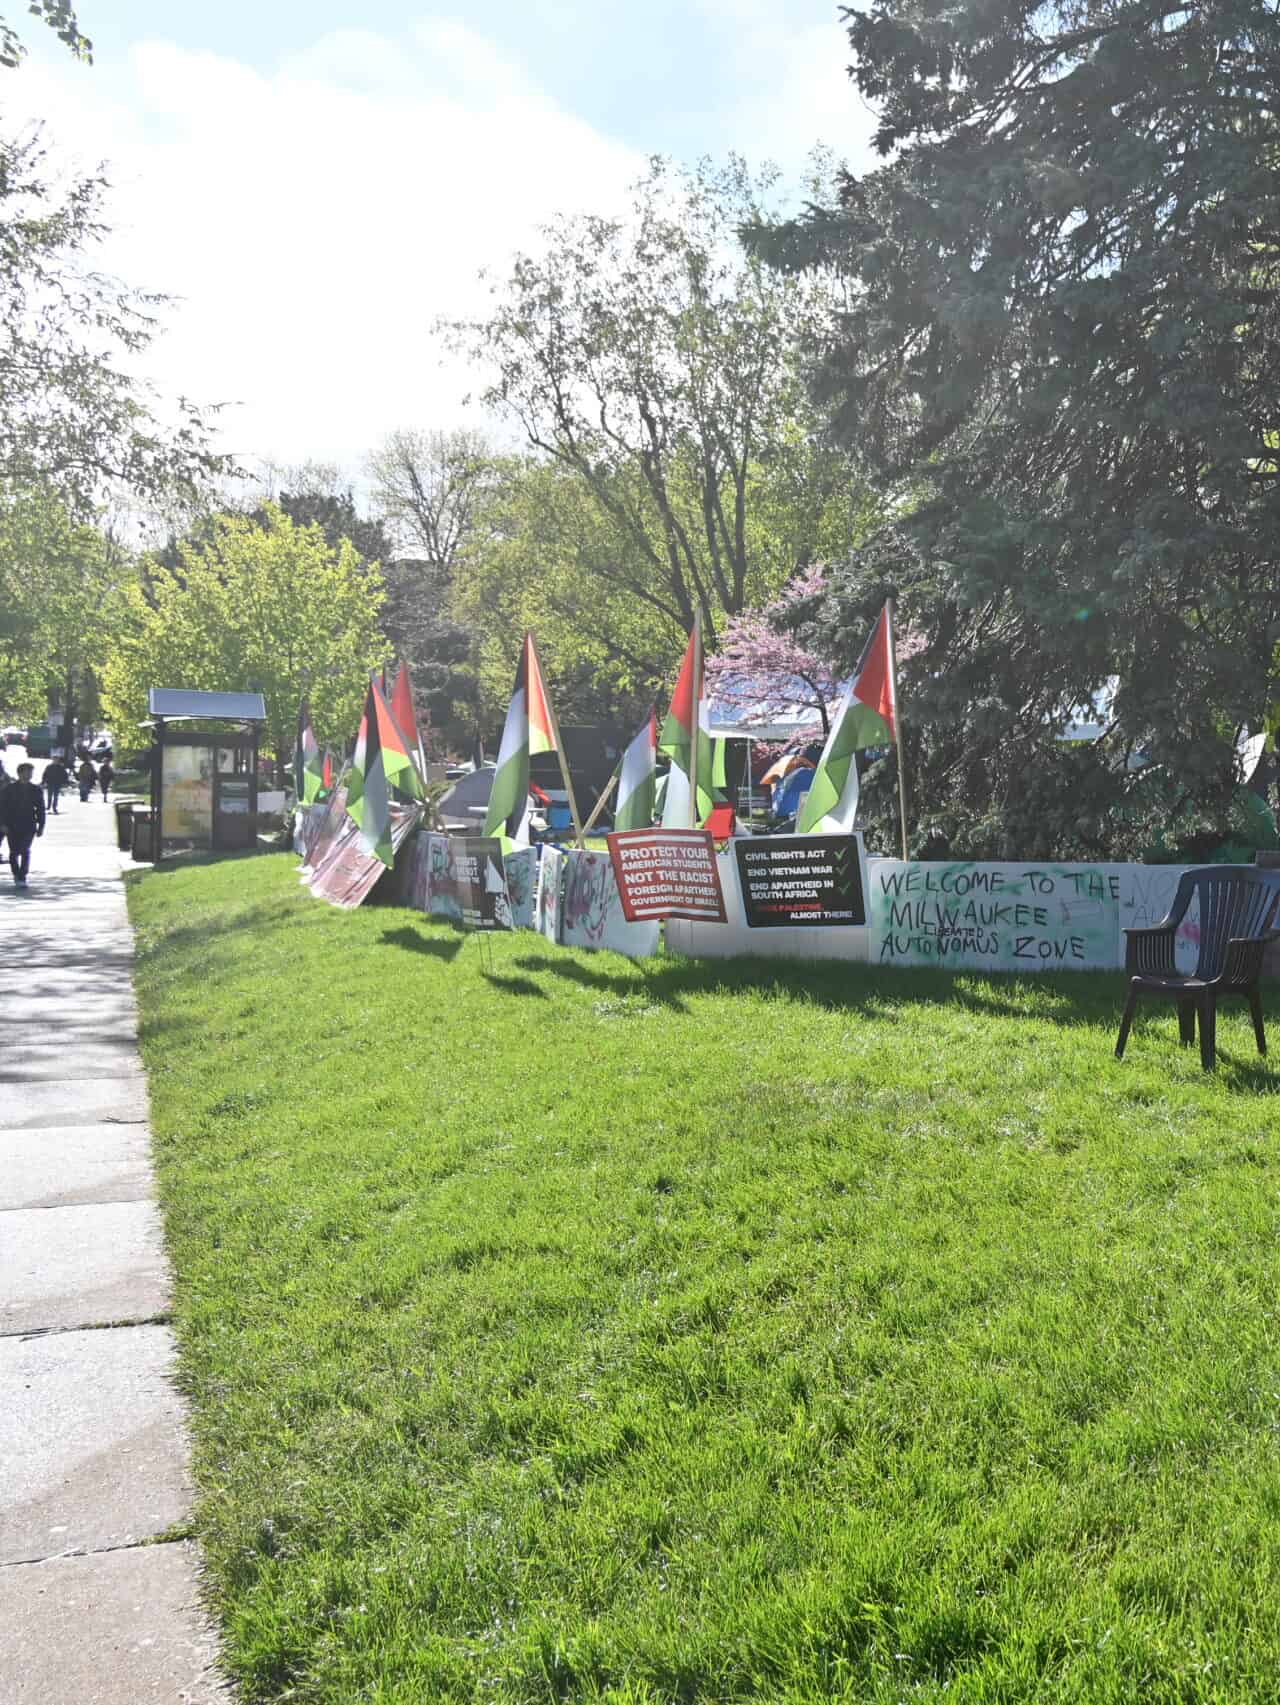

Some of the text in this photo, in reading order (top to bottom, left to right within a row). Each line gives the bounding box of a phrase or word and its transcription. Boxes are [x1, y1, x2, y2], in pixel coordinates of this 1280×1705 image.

[620, 846, 709, 860] PROTECT YOUR
[745, 849, 826, 861] CIVIL RIGHTS ACT
[622, 859, 672, 871] AMERICAN
[747, 865, 833, 877] END VIETNAM WAR
[624, 870, 714, 884] NOT THE RACIST
[627, 884, 673, 896] FOREIGN
[771, 880, 822, 890] APARTHEID
[823, 879, 834, 888] IN
[880, 870, 1121, 901] WELCOME TO THE
[751, 890, 819, 900] SOUTH AFRICA
[790, 911, 821, 920] ALMOST
[888, 900, 1049, 931] MILWAUKEE
[880, 932, 1086, 962] AUTONOMUS ZONE
